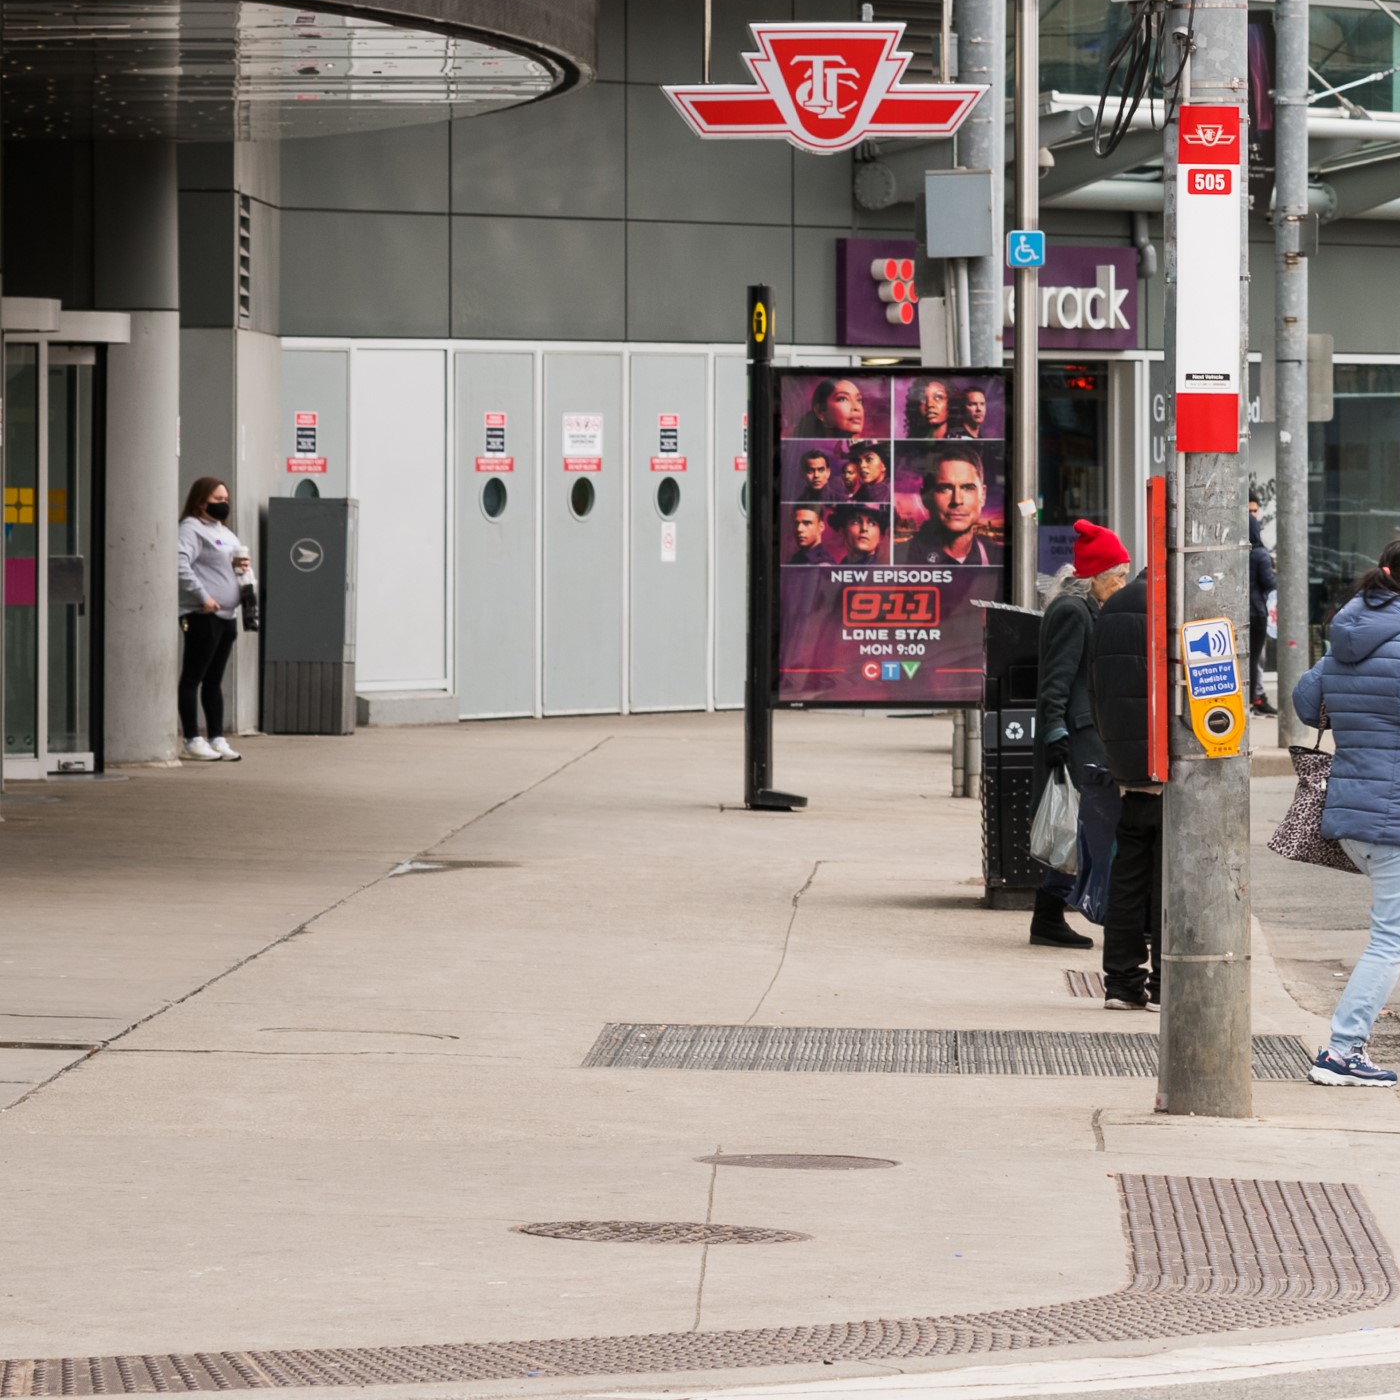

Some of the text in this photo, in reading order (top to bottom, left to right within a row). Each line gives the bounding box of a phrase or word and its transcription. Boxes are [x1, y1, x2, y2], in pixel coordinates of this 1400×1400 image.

[1194, 173, 1226, 191] 505
[831, 570, 953, 583] NEW EPISODES
[842, 629, 941, 640] LONE STAR
[860, 643, 926, 655] MON 9:00
[862, 660, 921, 680] CTV
[1192, 667, 1217, 677] Button
[1199, 674, 1228, 684] Audible
[1193, 681, 1234, 696] Signal Only
